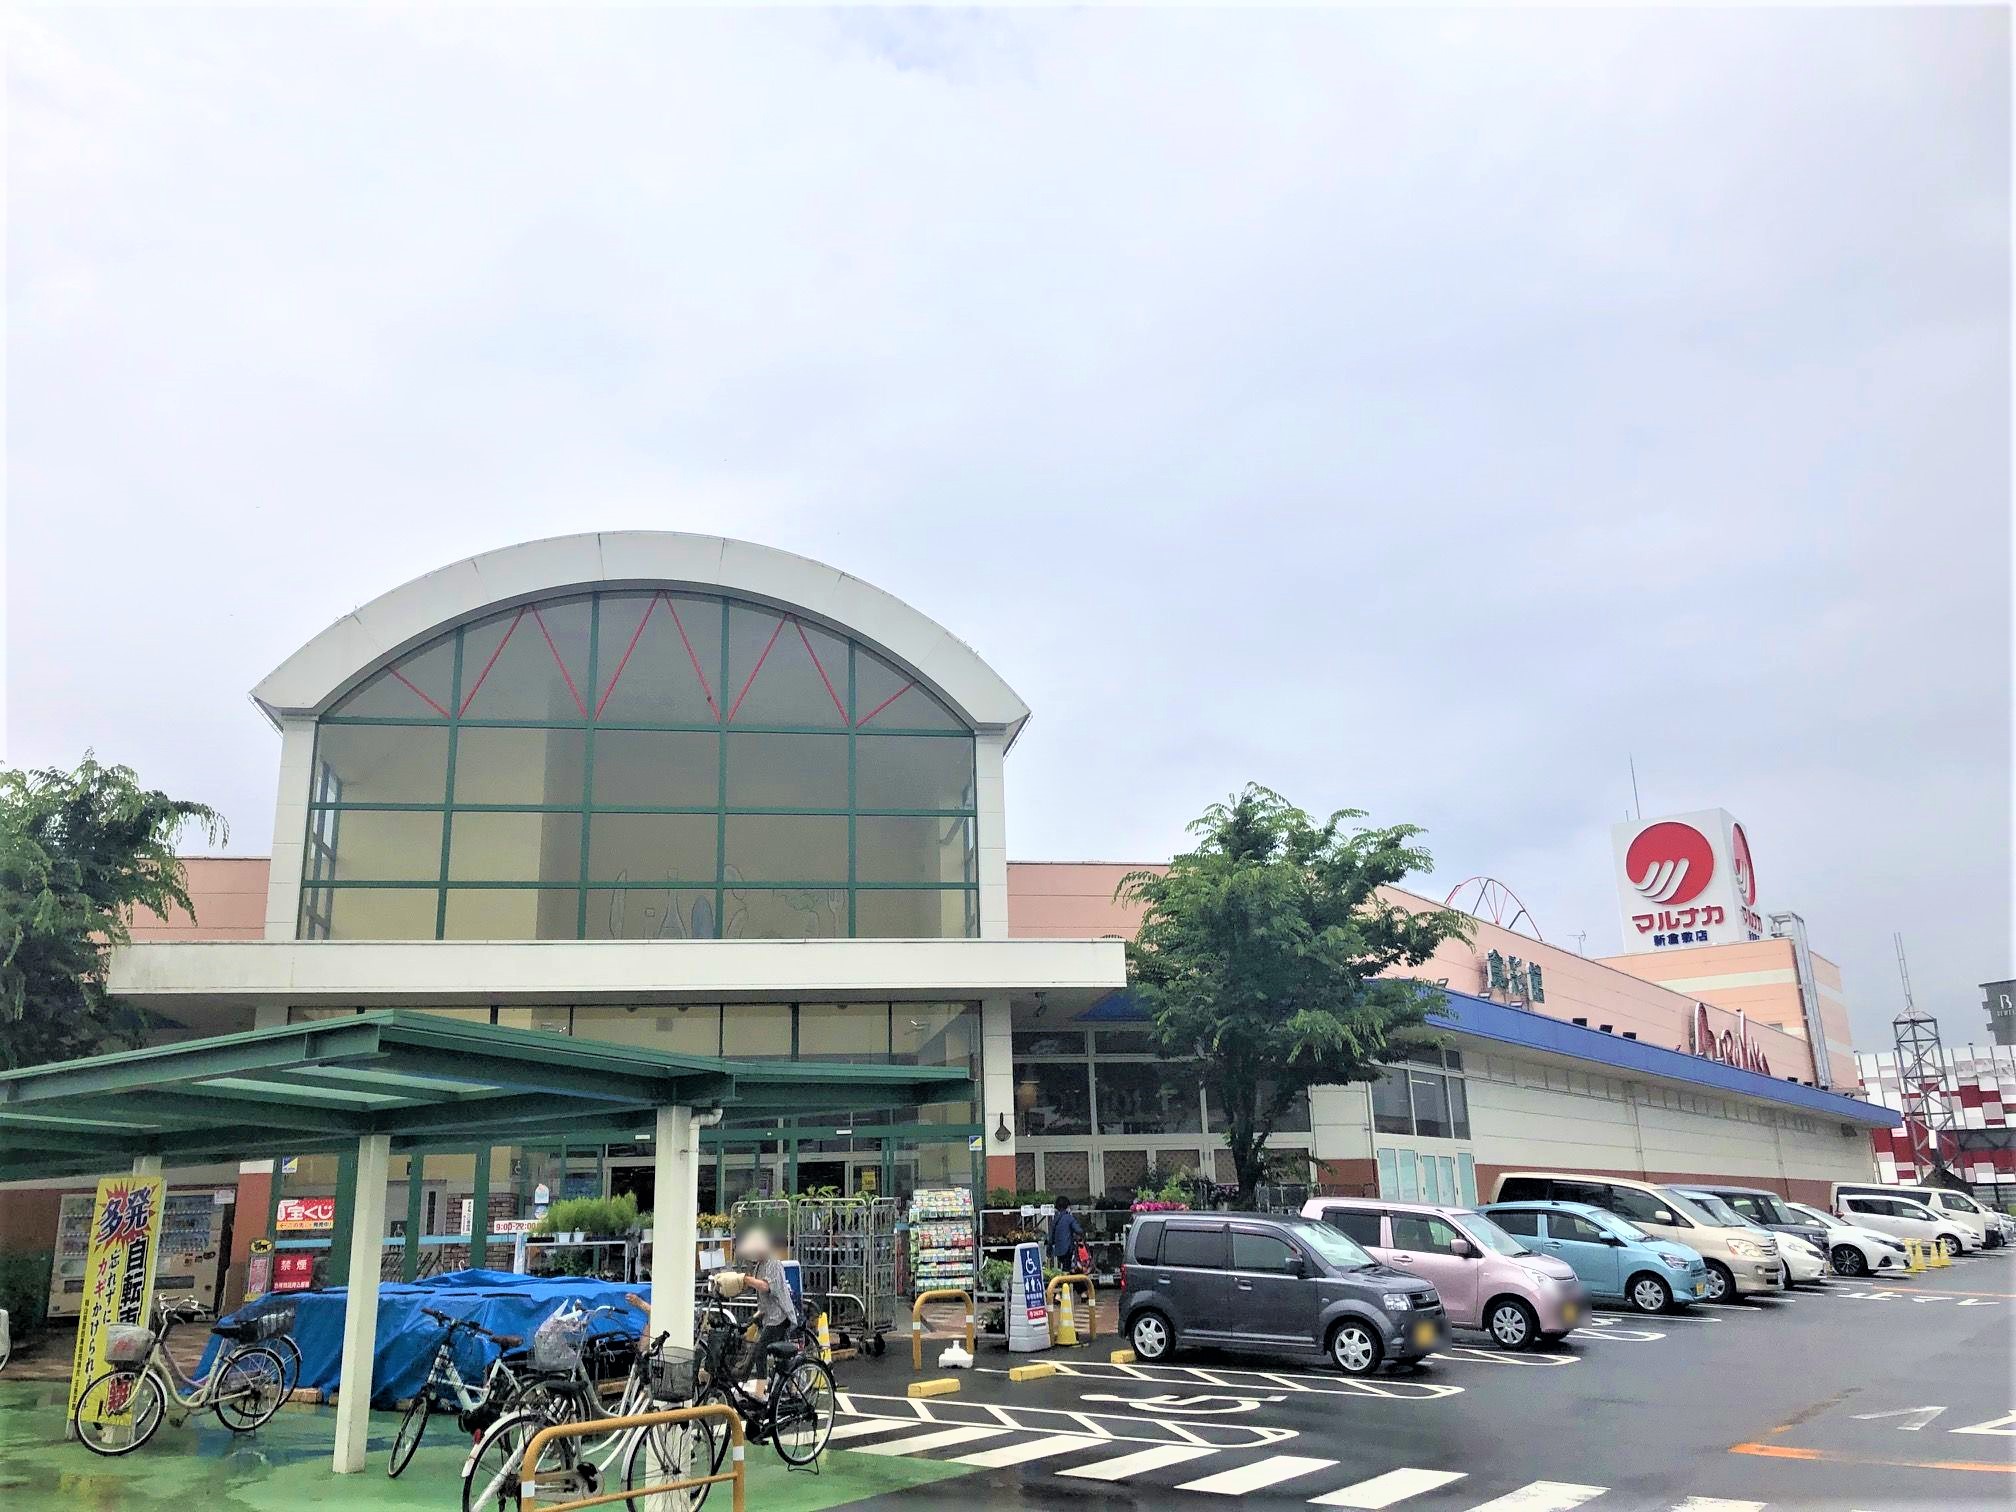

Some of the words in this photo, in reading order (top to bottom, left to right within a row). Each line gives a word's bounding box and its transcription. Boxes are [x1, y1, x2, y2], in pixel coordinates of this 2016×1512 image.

[1632, 905, 1725, 934] マルナカ
[1653, 930, 1709, 947] 新倉敷店
[286, 1204, 333, 1220] 宝くじ
